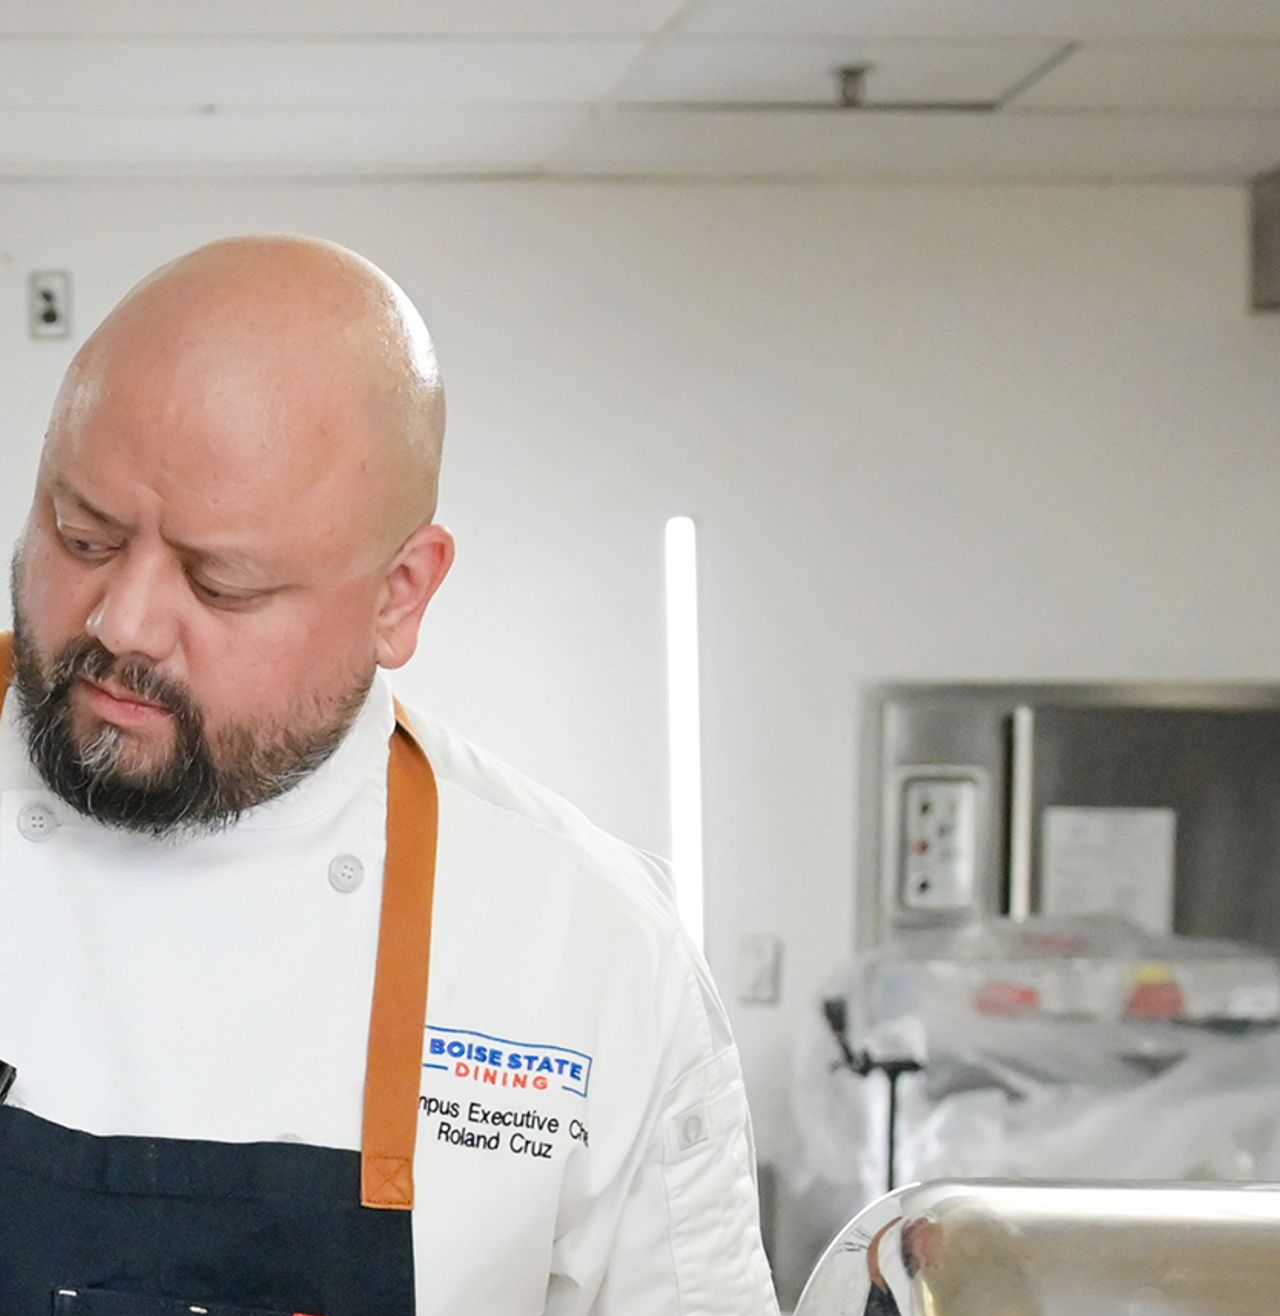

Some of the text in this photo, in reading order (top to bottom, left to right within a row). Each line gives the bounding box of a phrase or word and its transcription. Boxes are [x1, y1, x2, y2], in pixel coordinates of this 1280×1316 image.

[429, 1038, 584, 1082] BOISE STATE
[454, 1062, 550, 1091] DINING
[467, 1102, 560, 1134] Executive
[436, 1122, 554, 1159] Roland Cruz
